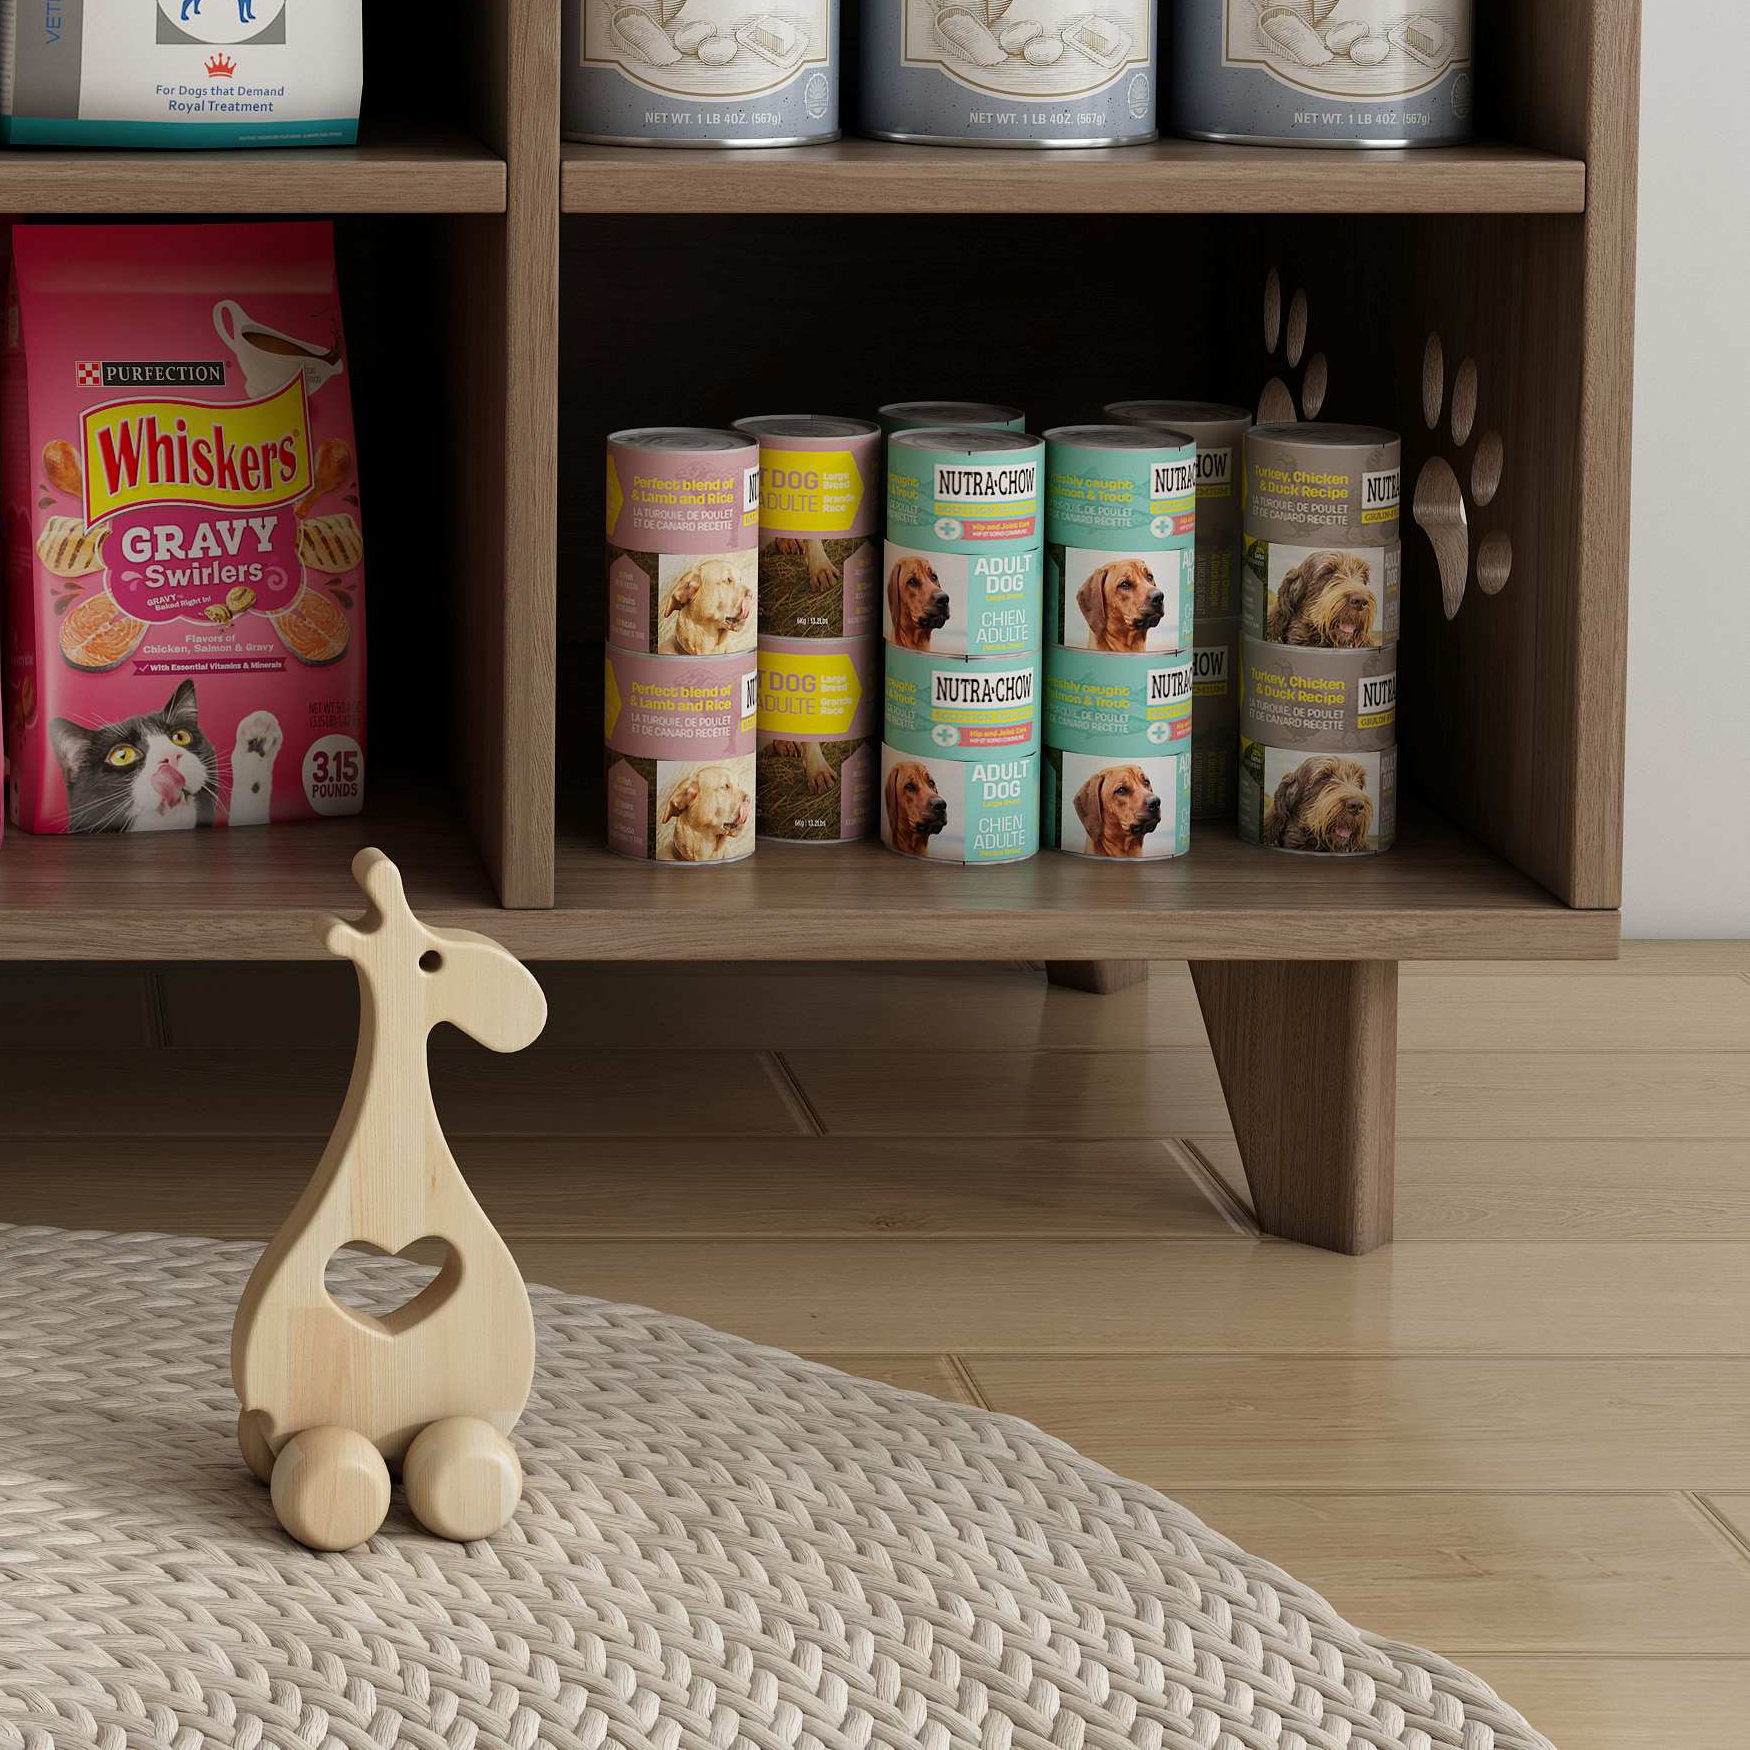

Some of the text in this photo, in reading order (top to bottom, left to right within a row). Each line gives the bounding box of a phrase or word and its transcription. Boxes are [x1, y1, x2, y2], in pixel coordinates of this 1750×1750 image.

[645, 112, 667, 124] NET
[670, 113, 693, 124] WT.
[697, 113, 702, 124] 1
[706, 113, 721, 125] LB
[97, 416, 297, 496] Whiskers
[682, 479, 720, 491] blend
[722, 477, 735, 489] of
[772, 471, 819, 490] DOG
[1293, 470, 1349, 485] Chicken
[641, 491, 677, 503] Lamb
[680, 494, 704, 505] and
[708, 492, 734, 504] Rice
[1259, 482, 1349, 500] & Duck Recipe
[973, 554, 1032, 576] ADULT
[985, 574, 1024, 594] DOG
[980, 609, 1026, 628] CHIEN
[976, 623, 1028, 644] ADULTE
